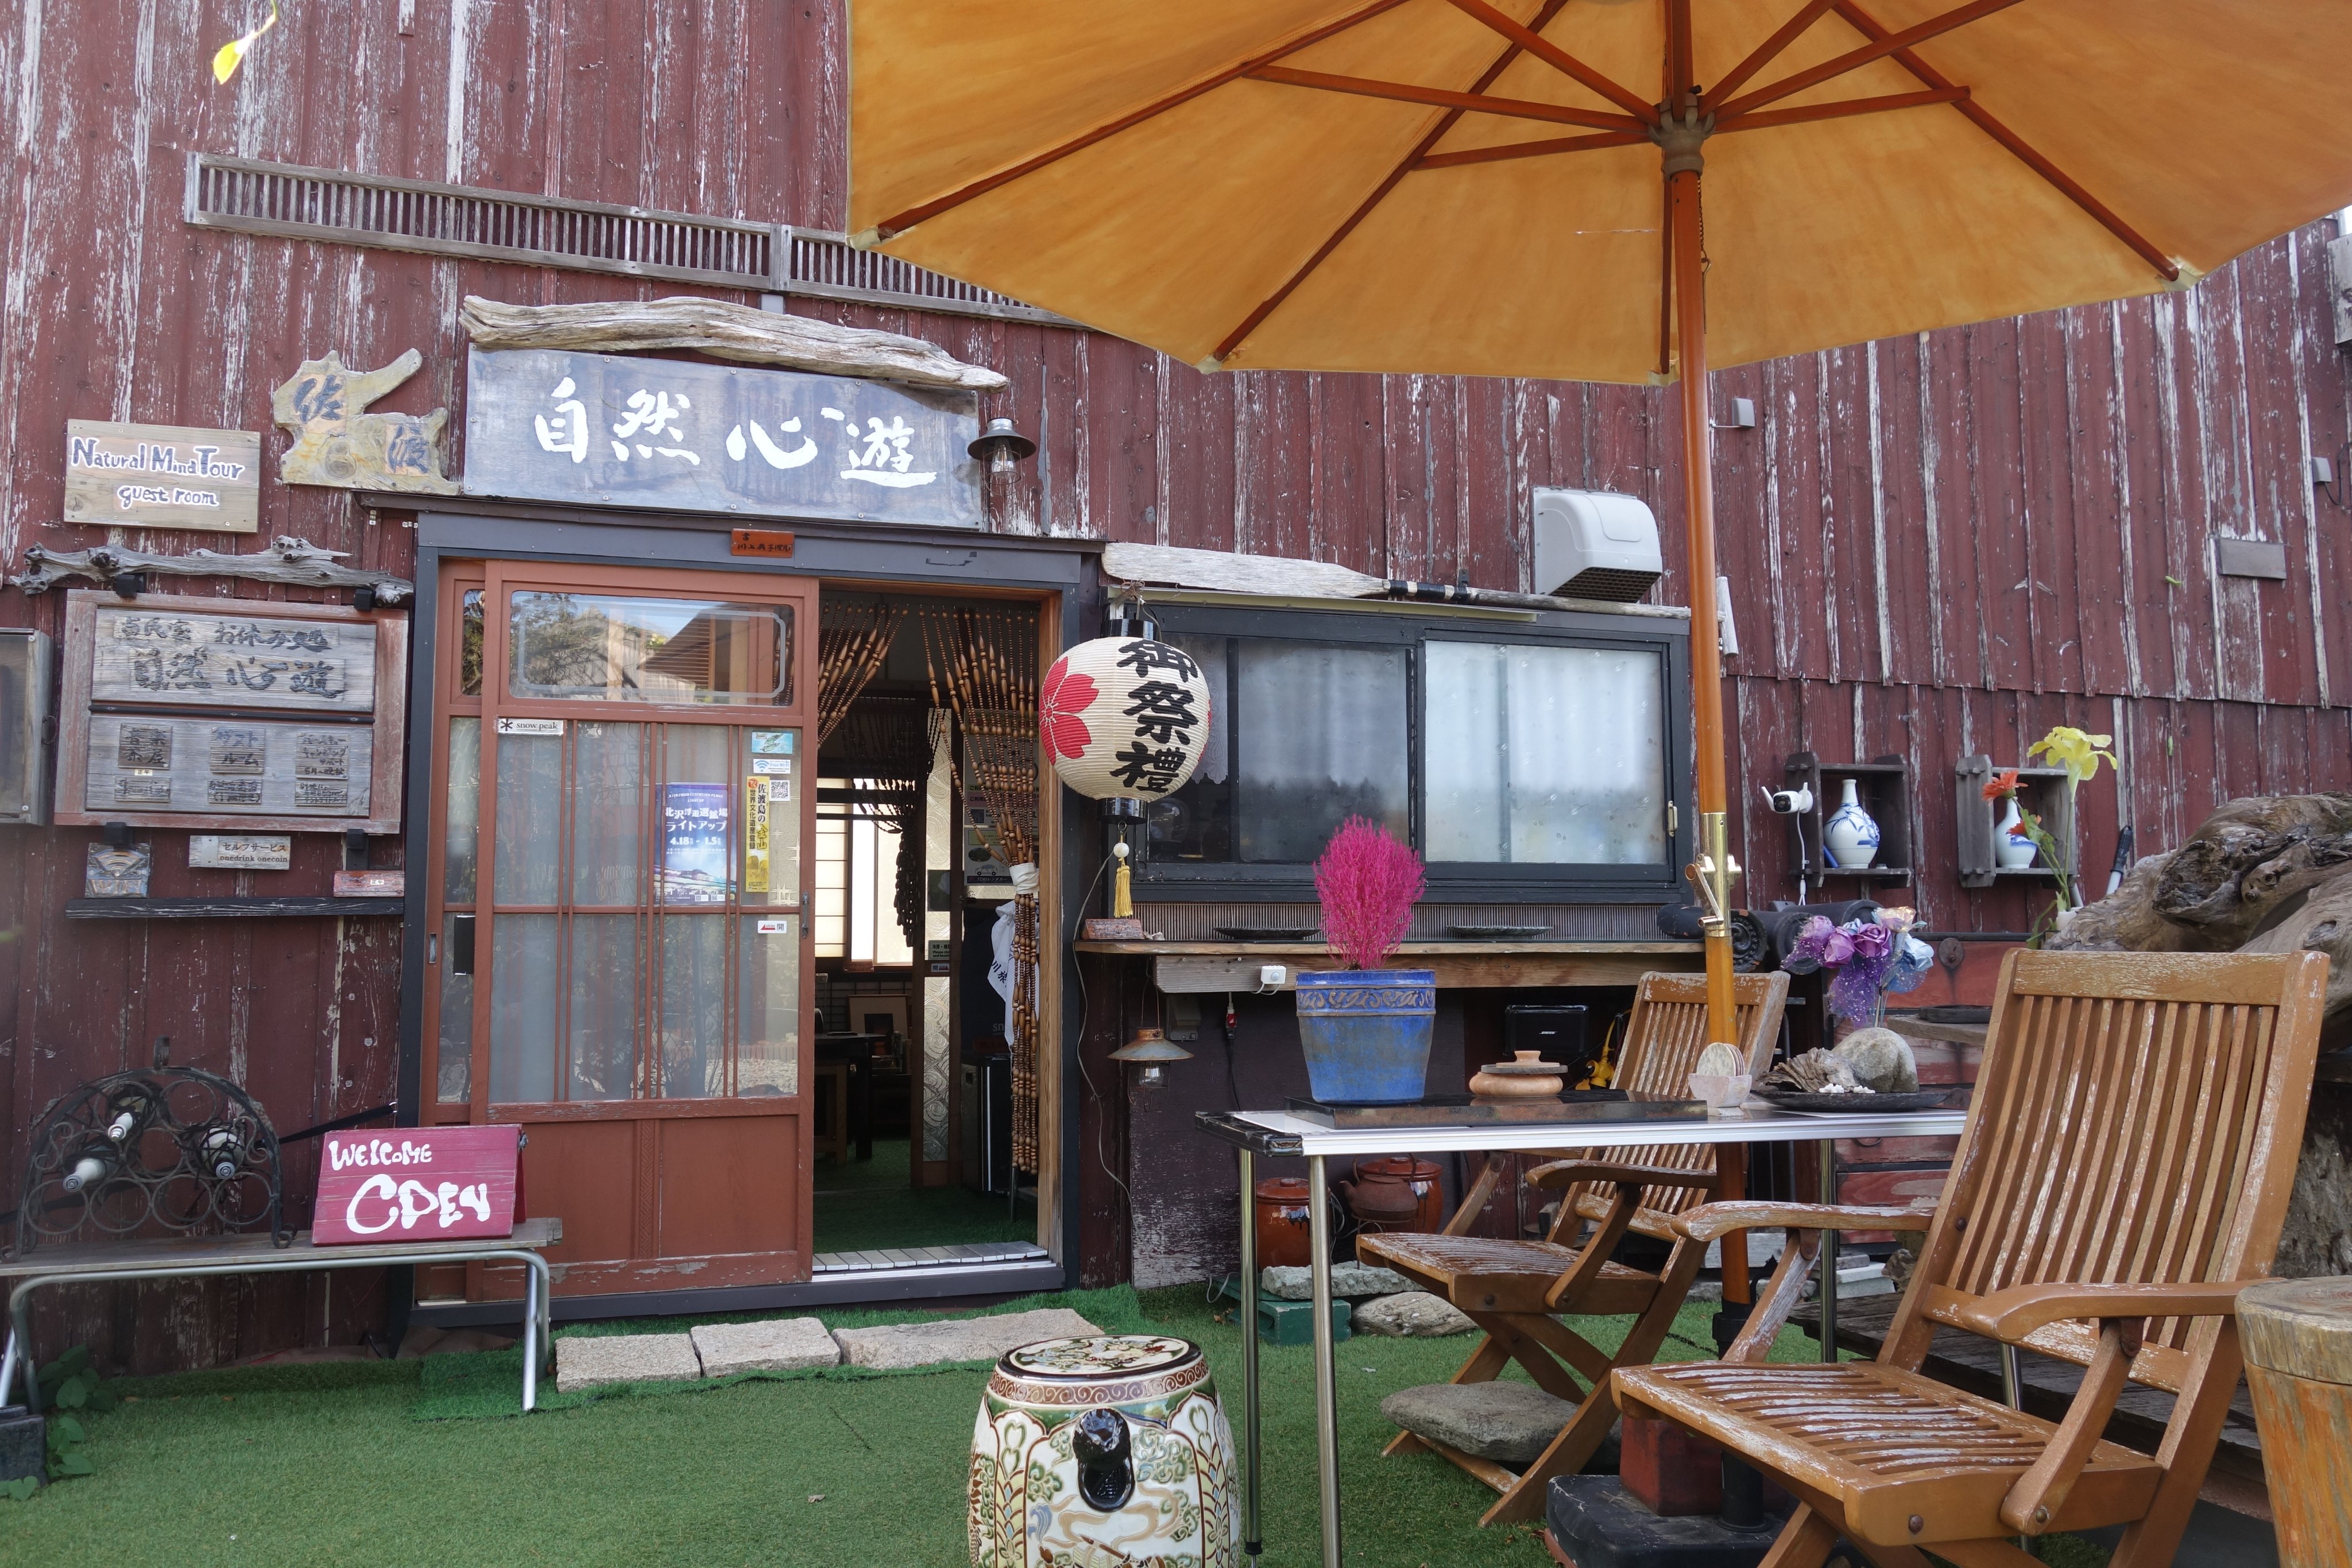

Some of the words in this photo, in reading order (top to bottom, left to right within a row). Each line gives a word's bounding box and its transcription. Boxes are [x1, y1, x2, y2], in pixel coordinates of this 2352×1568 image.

[535, 377, 937, 487] 自然心遊
[72, 437, 146, 470] Natural
[150, 446, 198, 475] Mind
[194, 446, 245, 479] Tour
[118, 486, 170, 509] guest
[173, 487, 219, 506] room
[539, 722, 558, 731] peak
[666, 820, 728, 832] ライトアップ
[223, 842, 286, 852] セルフサービス
